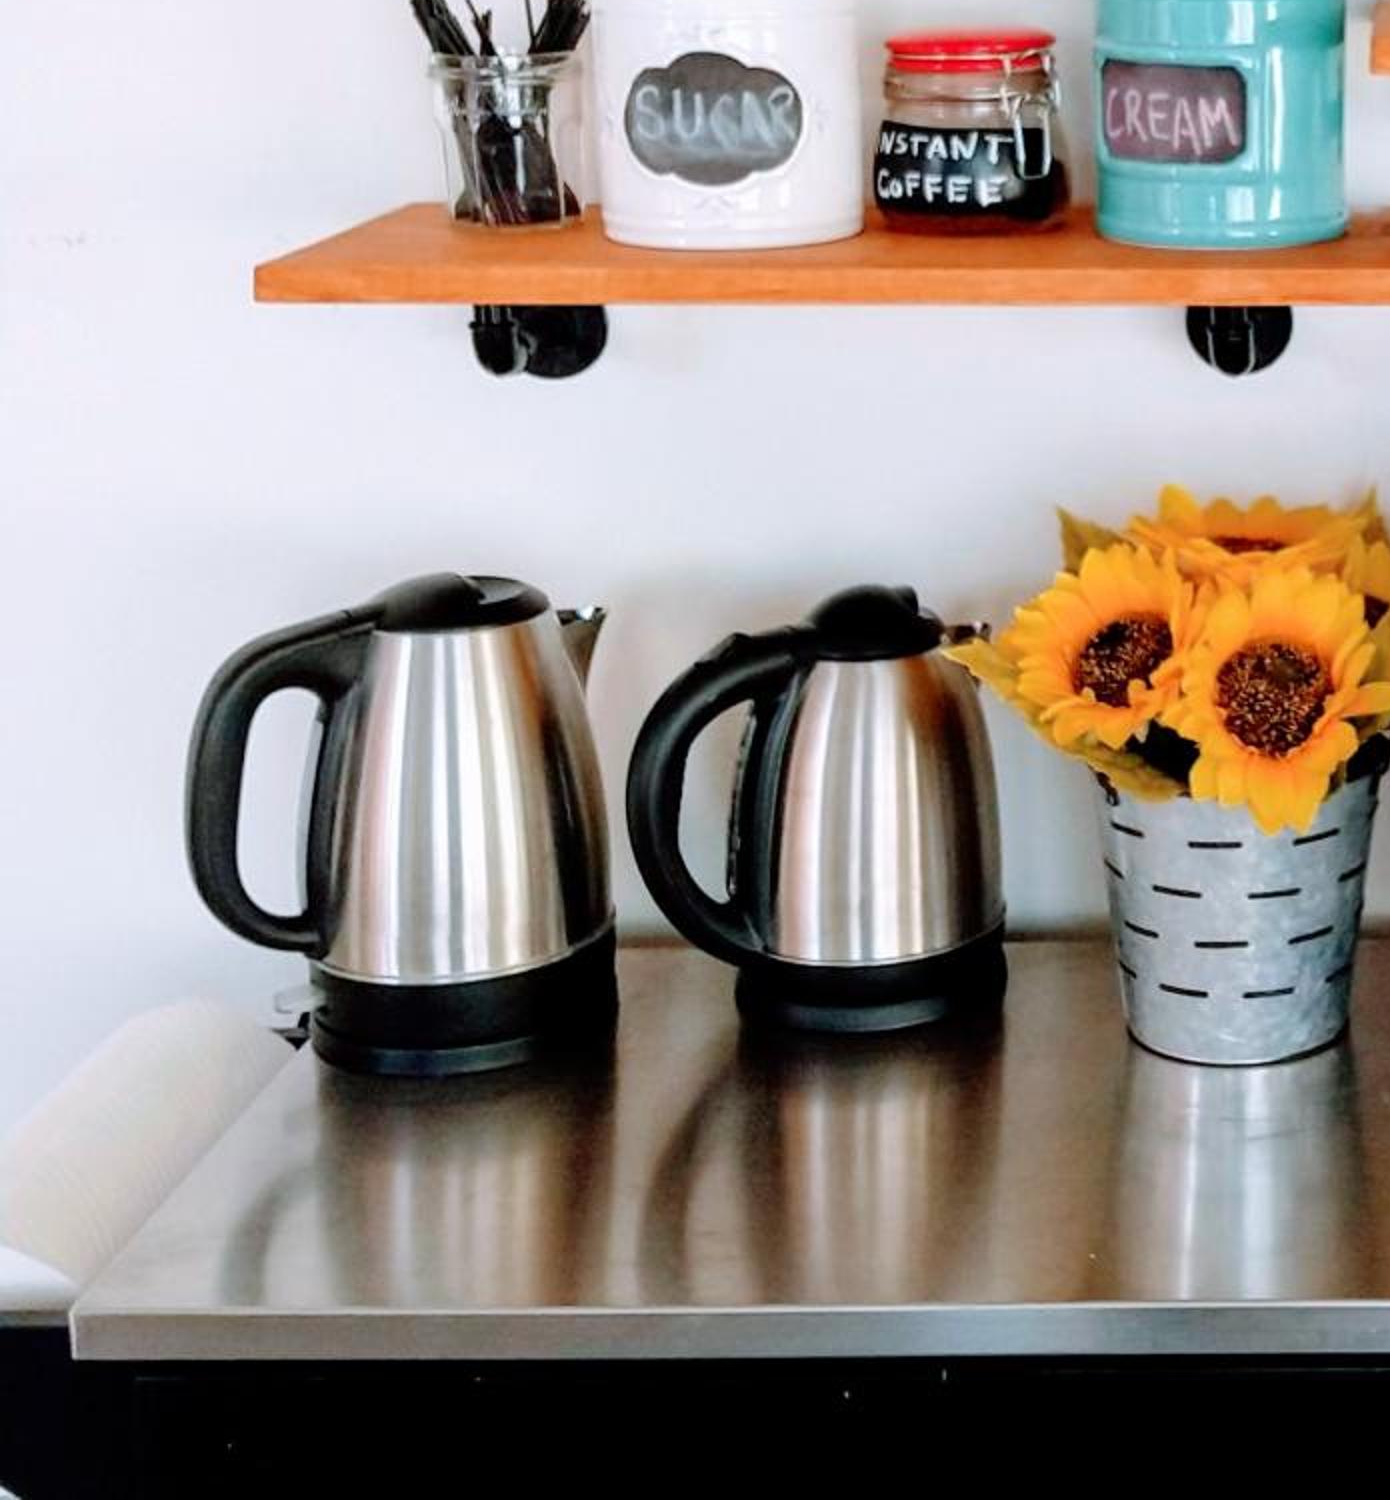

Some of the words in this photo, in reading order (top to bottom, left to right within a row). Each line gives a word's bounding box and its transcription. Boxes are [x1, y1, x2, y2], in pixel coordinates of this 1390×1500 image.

[634, 84, 796, 151] SUGAR
[875, 130, 1013, 165] NSTANT
[1106, 88, 1242, 156] CREAM
